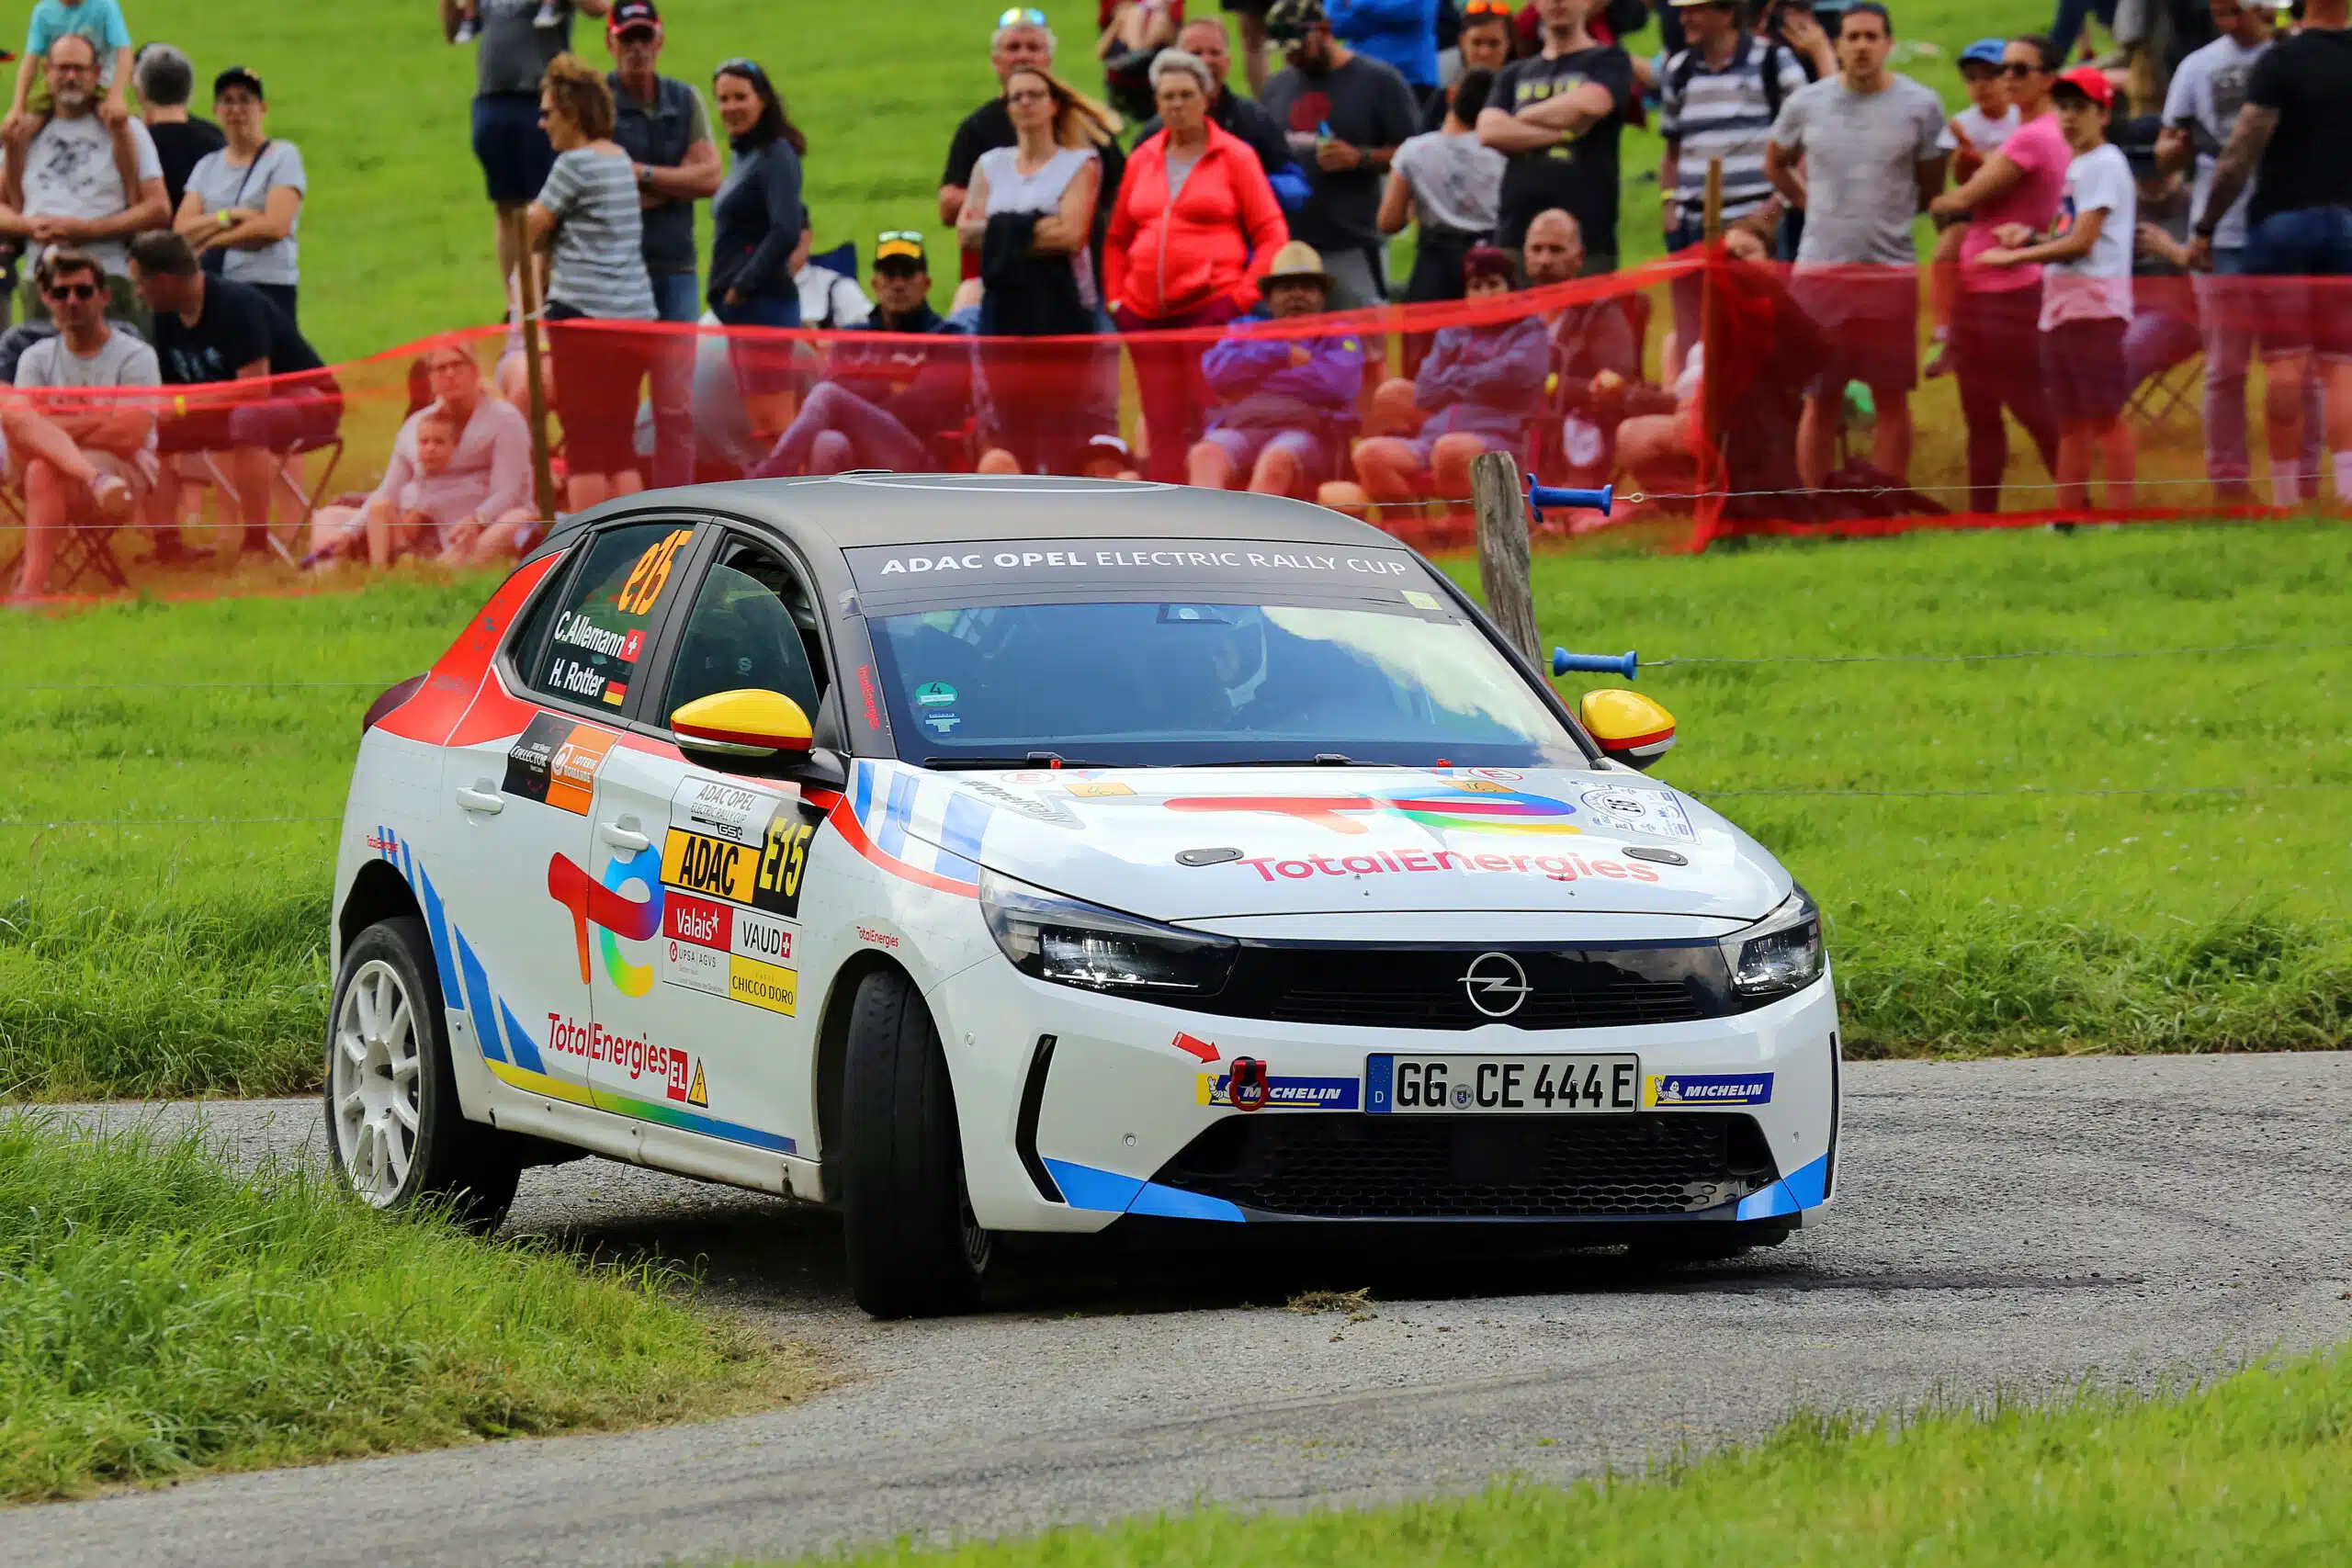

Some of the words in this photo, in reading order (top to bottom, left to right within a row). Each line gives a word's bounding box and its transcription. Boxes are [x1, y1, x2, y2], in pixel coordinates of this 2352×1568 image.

[617, 529, 694, 616] e15
[880, 554, 983, 575] ADAC
[993, 551, 1087, 568] OPEL
[1094, 551, 1240, 568] ELECTRIC
[1247, 553, 1336, 571] RALLY
[1346, 558, 1408, 577] CUP
[554, 610, 627, 659] C.Allemann
[548, 657, 566, 688] H.
[562, 661, 606, 698] Rotter
[930, 682, 943, 695] 4
[509, 745, 548, 768] COLLECTOR
[690, 802, 718, 818] ELECTRIC
[695, 784, 731, 805] ADAC
[728, 791, 757, 812] OPEL
[959, 780, 1074, 823] #OpelRally
[678, 837, 740, 897] ADAC
[758, 816, 813, 897] E15
[1234, 848, 1660, 884] TotalEnergies
[676, 906, 714, 942] Valais
[742, 920, 781, 956] VAUD
[856, 926, 899, 949] TotalEnergies
[678, 948, 695, 963] UPSA
[698, 956, 717, 968] AGVS
[731, 975, 767, 998] CHICCO
[548, 1012, 668, 1080] TotalEnergies
[670, 1060, 687, 1089] EL
[1396, 1062, 1449, 1108] GG
[1476, 1062, 1526, 1109] CE
[1243, 1084, 1342, 1100] MCHELIN
[1374, 1090, 1385, 1103] D
[1683, 1082, 1765, 1099] MICHELIN
